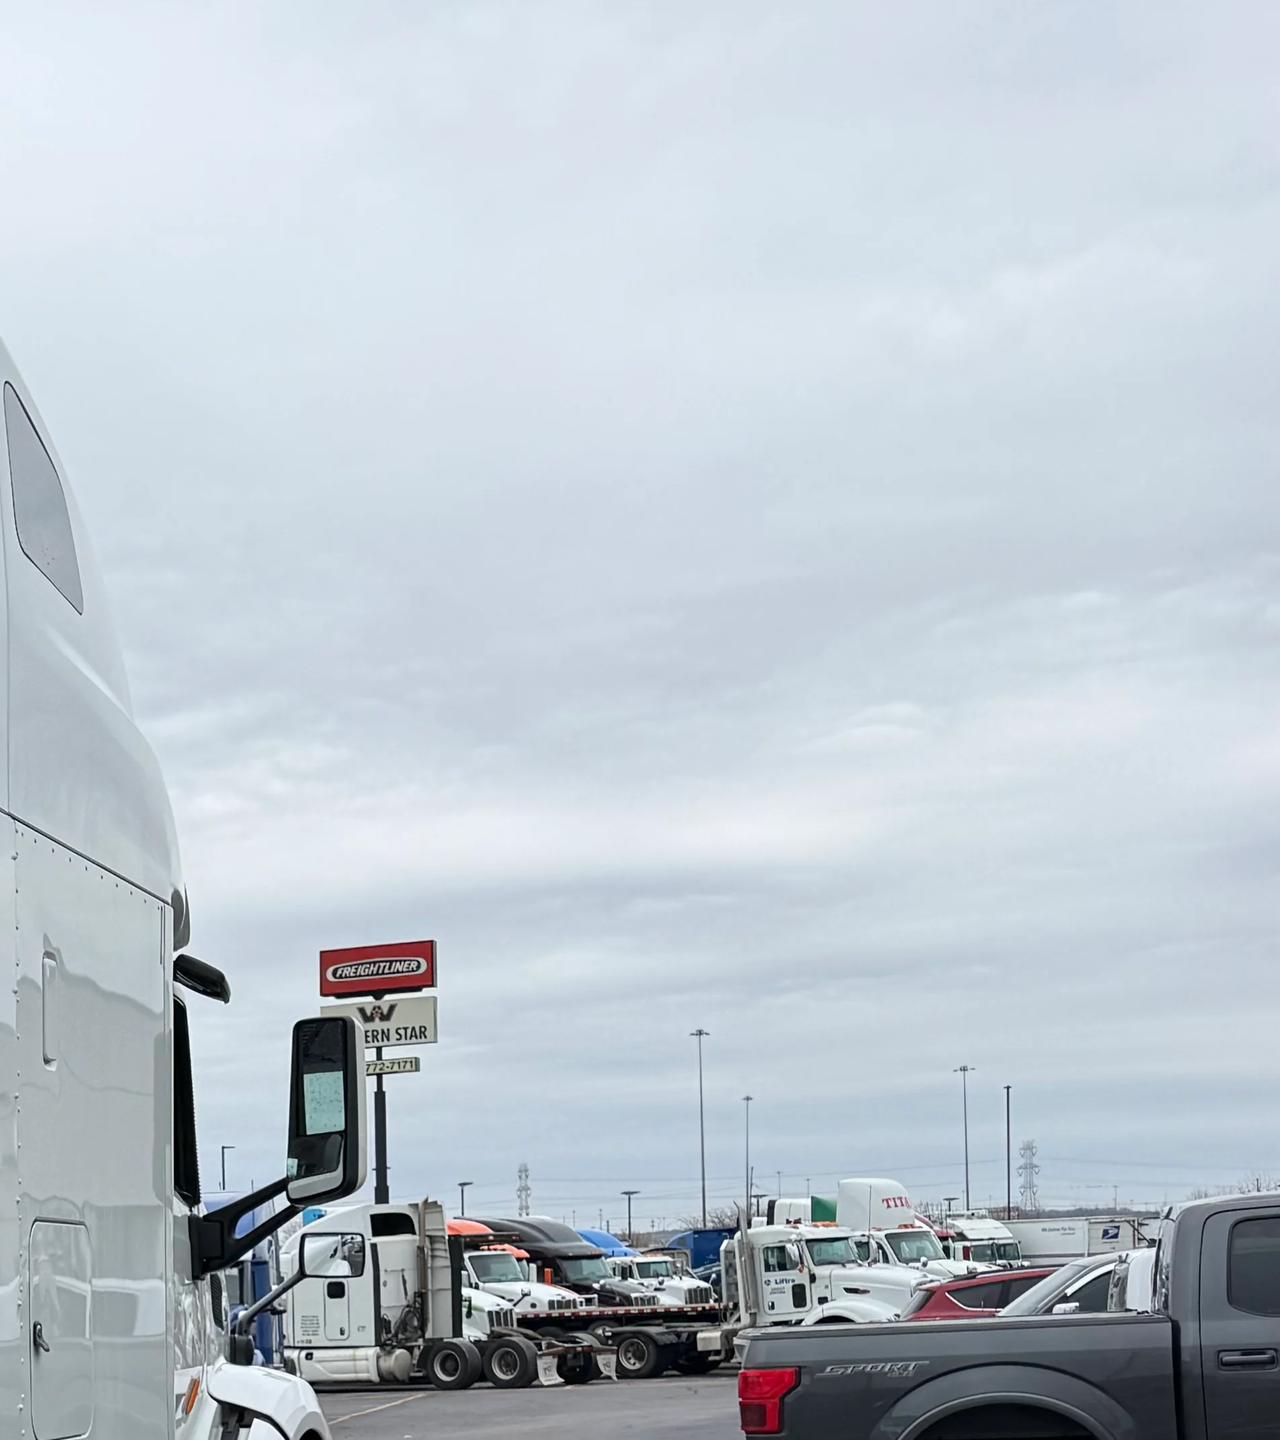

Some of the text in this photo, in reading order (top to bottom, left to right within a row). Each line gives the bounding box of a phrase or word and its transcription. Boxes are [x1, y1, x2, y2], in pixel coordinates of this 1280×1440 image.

[335, 960, 419, 978] FREIGHTLINER
[395, 1025, 428, 1041] STAR
[816, 1360, 930, 1376] SPORT
